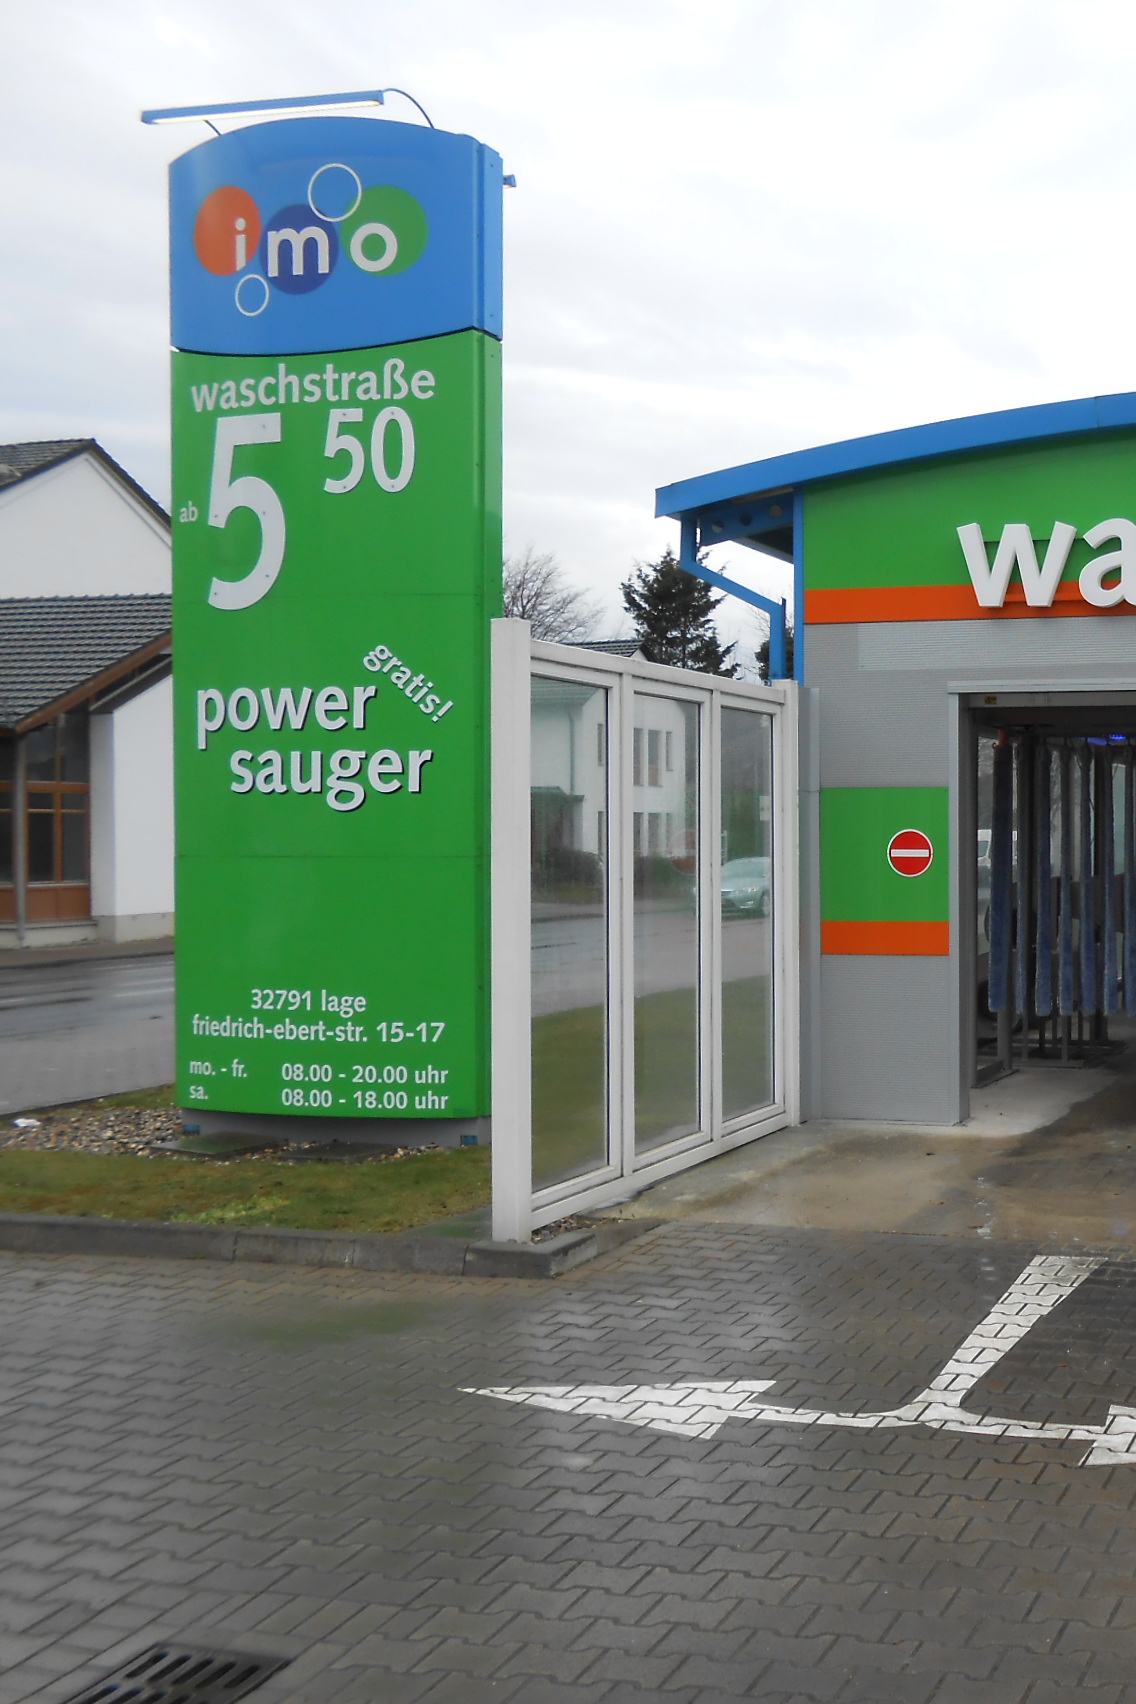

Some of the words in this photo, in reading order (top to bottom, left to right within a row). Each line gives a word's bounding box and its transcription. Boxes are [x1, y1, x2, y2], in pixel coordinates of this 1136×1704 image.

[234, 217, 398, 278] imo
[190, 358, 436, 412] waschstraße
[179, 501, 198, 523] ab
[208, 412, 286, 611] 5
[323, 406, 416, 494] 50
[363, 644, 454, 723] gratis!
[197, 685, 378, 751] power
[229, 749, 435, 812] sauger
[192, 1013, 369, 1042] friedrich-ebert-str.
[376, 1021, 446, 1043] 15-17
[250, 989, 313, 1011] 32791
[320, 989, 367, 1018] lage
[189, 1060, 216, 1076] mo.
[232, 1058, 248, 1078] fr.
[281, 1063, 333, 1083] 08.00
[351, 1065, 408, 1084] 20.00
[414, 1064, 449, 1085] uhr
[189, 1085, 209, 1100] sa.
[281, 1088, 333, 1108] 08.00
[353, 1091, 408, 1110] 18.00
[414, 1090, 449, 1110] uhr
